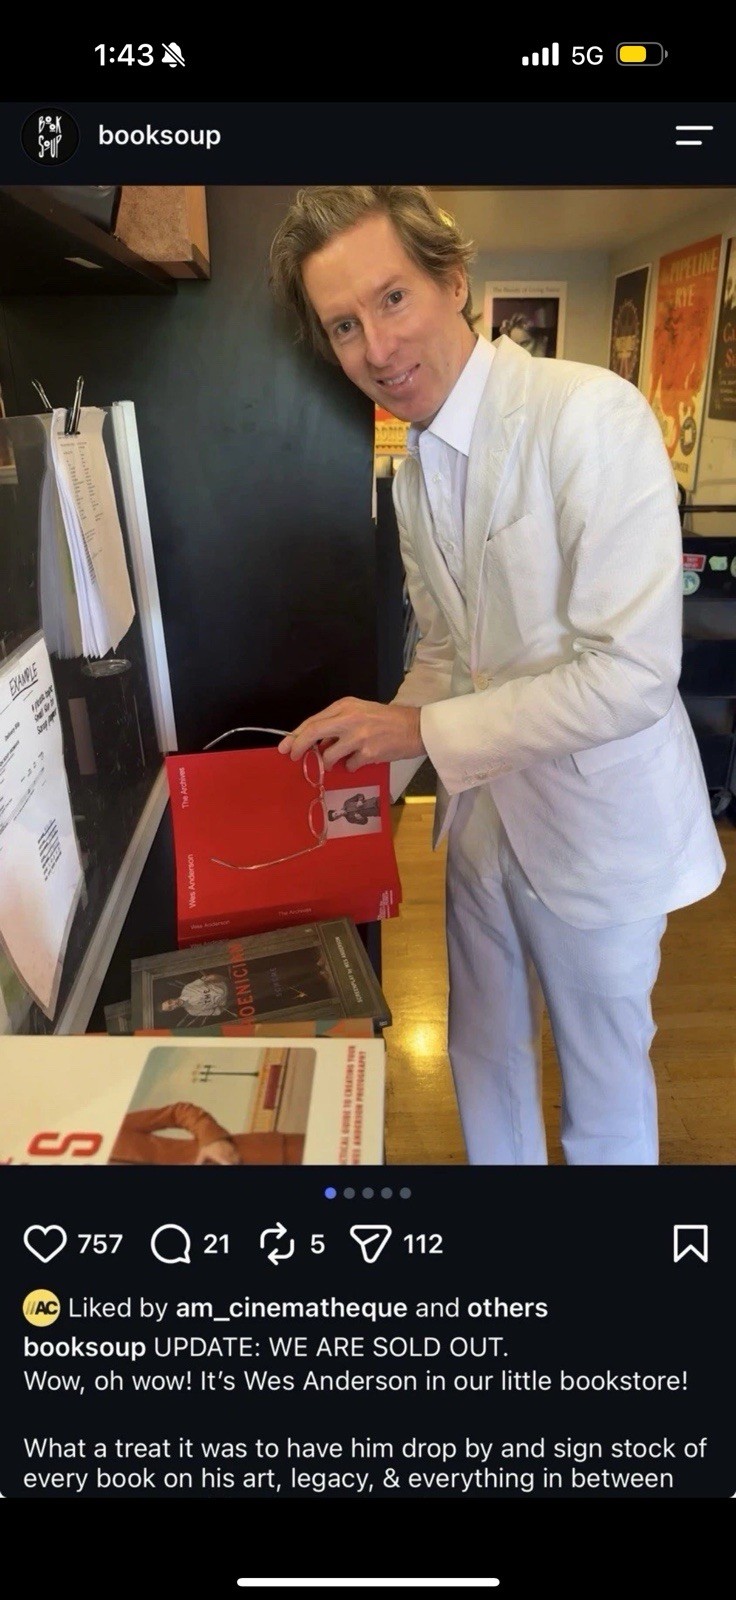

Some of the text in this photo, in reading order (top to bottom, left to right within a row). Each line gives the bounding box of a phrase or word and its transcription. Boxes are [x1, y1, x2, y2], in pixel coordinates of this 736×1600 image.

[9, 662, 37, 696] EXAMPLE
[179, 767, 189, 809] The Archives
[203, 989, 211, 1004] THE
[347, 1046, 355, 1061] YOUR
[344, 1064, 354, 1097] CREATING
[356, 1051, 366, 1102] PHOTOGRAPHY
[343, 1099, 352, 1107] TO
[341, 1111, 351, 1134] GUIDE
[353, 1104, 363, 1145] ANDERSON
